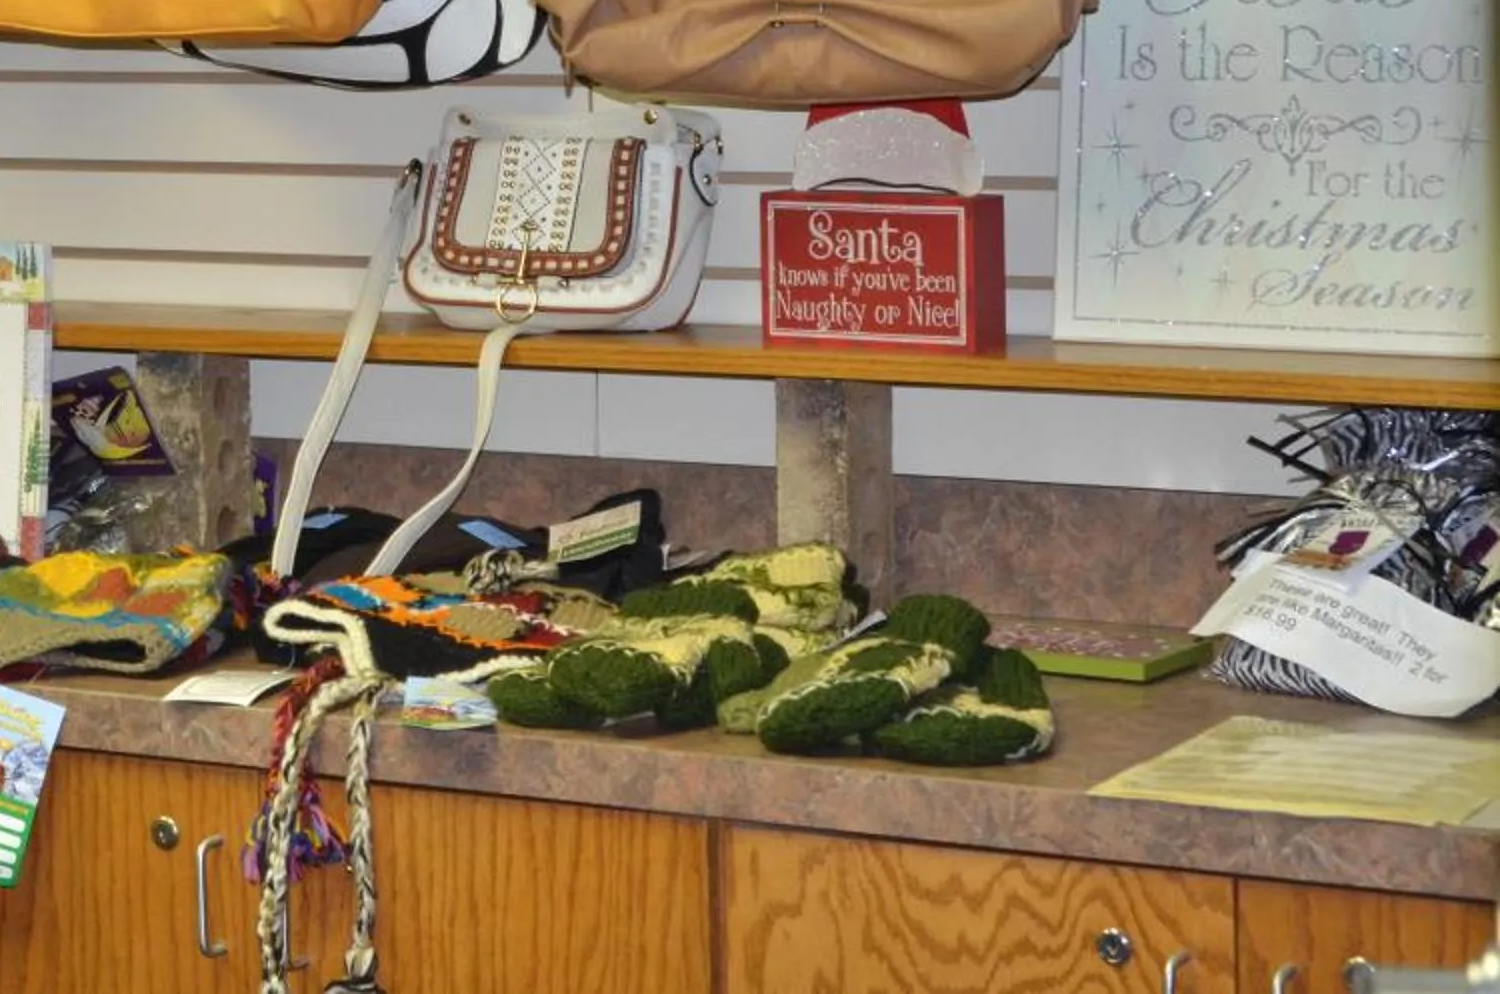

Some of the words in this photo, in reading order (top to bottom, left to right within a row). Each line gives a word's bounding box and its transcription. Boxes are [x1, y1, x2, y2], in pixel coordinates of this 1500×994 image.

[1118, 24, 1158, 82] Is
[1178, 20, 1259, 83] the
[1279, 24, 1485, 85] Reason
[1130, 158, 1466, 253] Christmas
[1304, 159, 1371, 199] For
[1383, 160, 1446, 200] the
[808, 210, 924, 266] Santa
[778, 261, 829, 288] knows
[834, 263, 850, 289] if
[852, 267, 911, 296] you've
[916, 266, 957, 294] been
[1248, 250, 1475, 312] Season
[775, 290, 867, 331] Naughty
[874, 306, 902, 326] or
